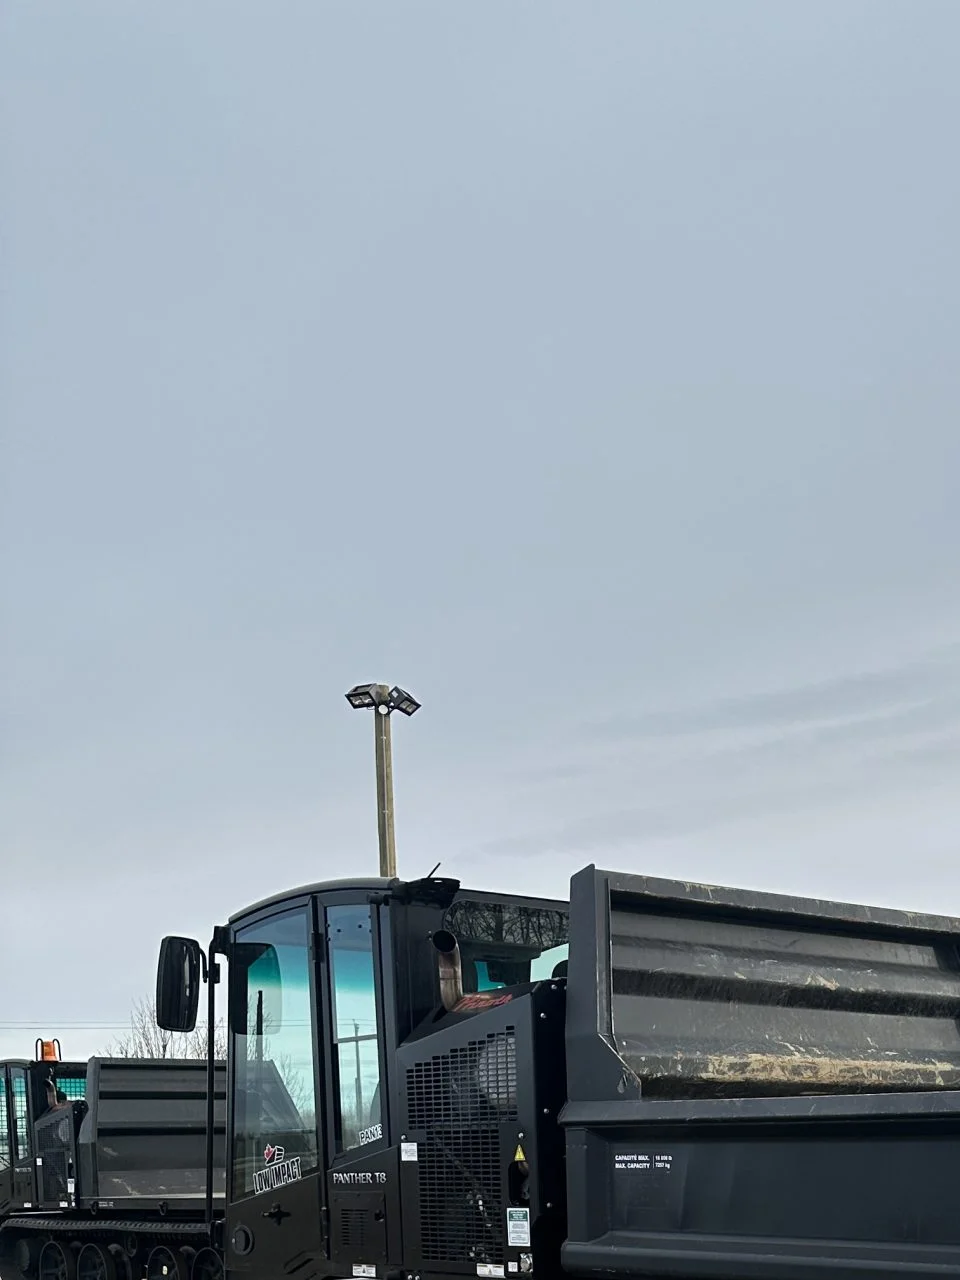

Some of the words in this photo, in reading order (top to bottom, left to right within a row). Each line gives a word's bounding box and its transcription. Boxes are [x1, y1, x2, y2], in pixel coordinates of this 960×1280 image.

[253, 1168, 271, 1194] LOW
[271, 1157, 301, 1188] IMPACT
[333, 1173, 372, 1183] PANTHER
[374, 1172, 386, 1183] T8
